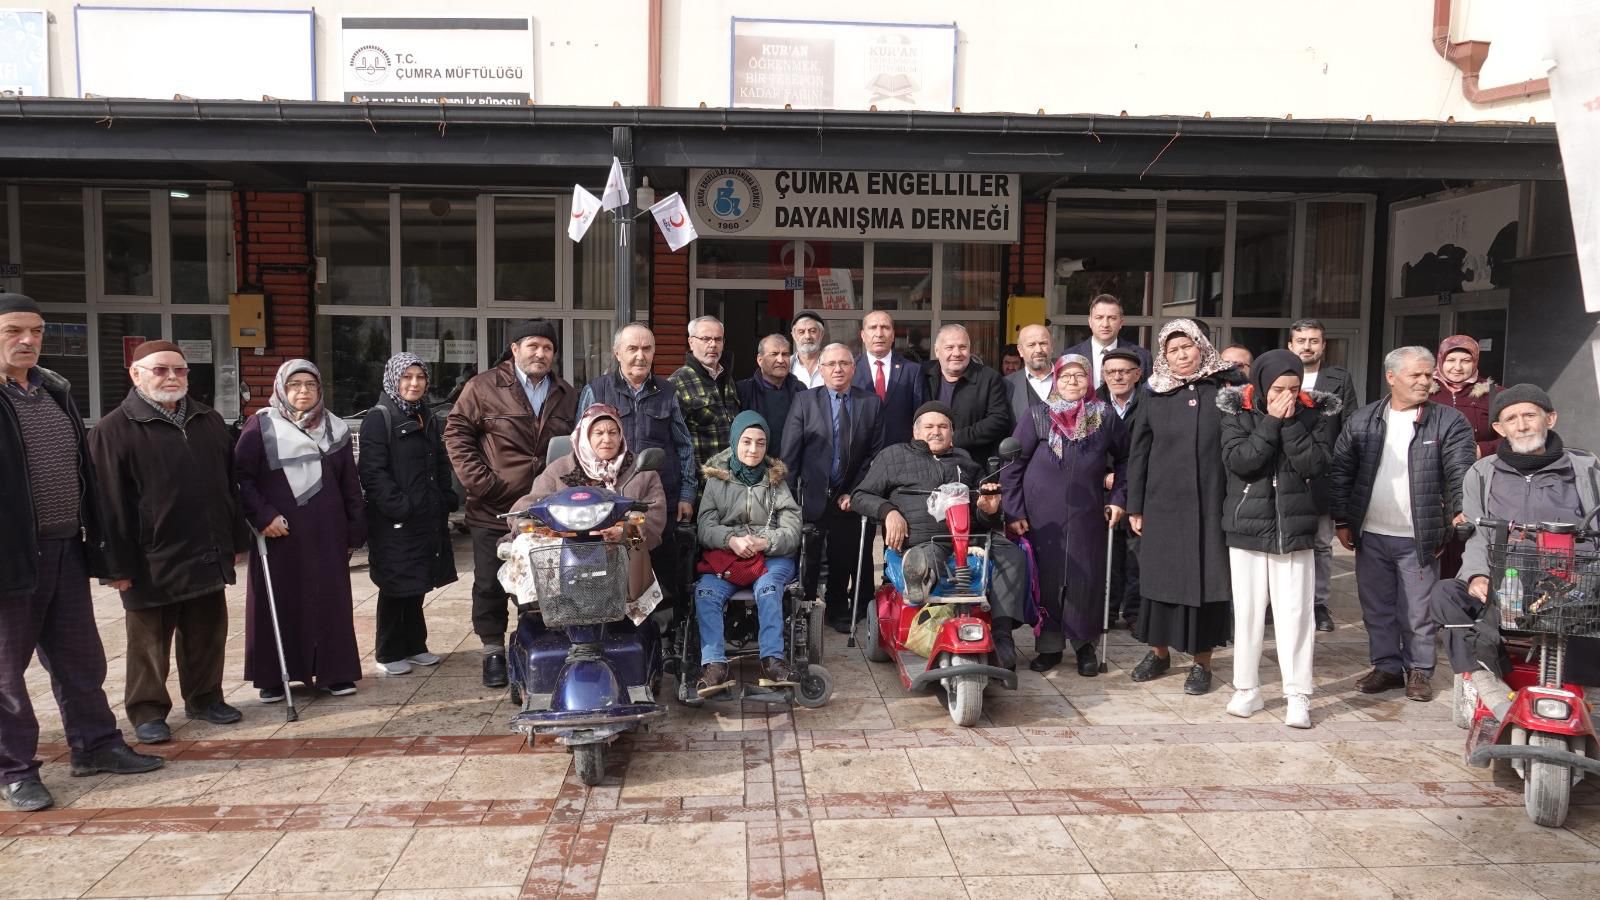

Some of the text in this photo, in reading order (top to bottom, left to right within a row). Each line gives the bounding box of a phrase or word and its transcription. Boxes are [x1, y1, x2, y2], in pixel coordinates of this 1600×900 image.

[395, 53, 417, 64] T.C.
[395, 66, 524, 80] ÇUMRA MÜFTÜLÜĞÜ
[775, 171, 860, 199] ÇUMRA
[718, 222, 740, 230] 1960
[775, 204, 1009, 234] DAYANIŞMA DERNEĞİ
